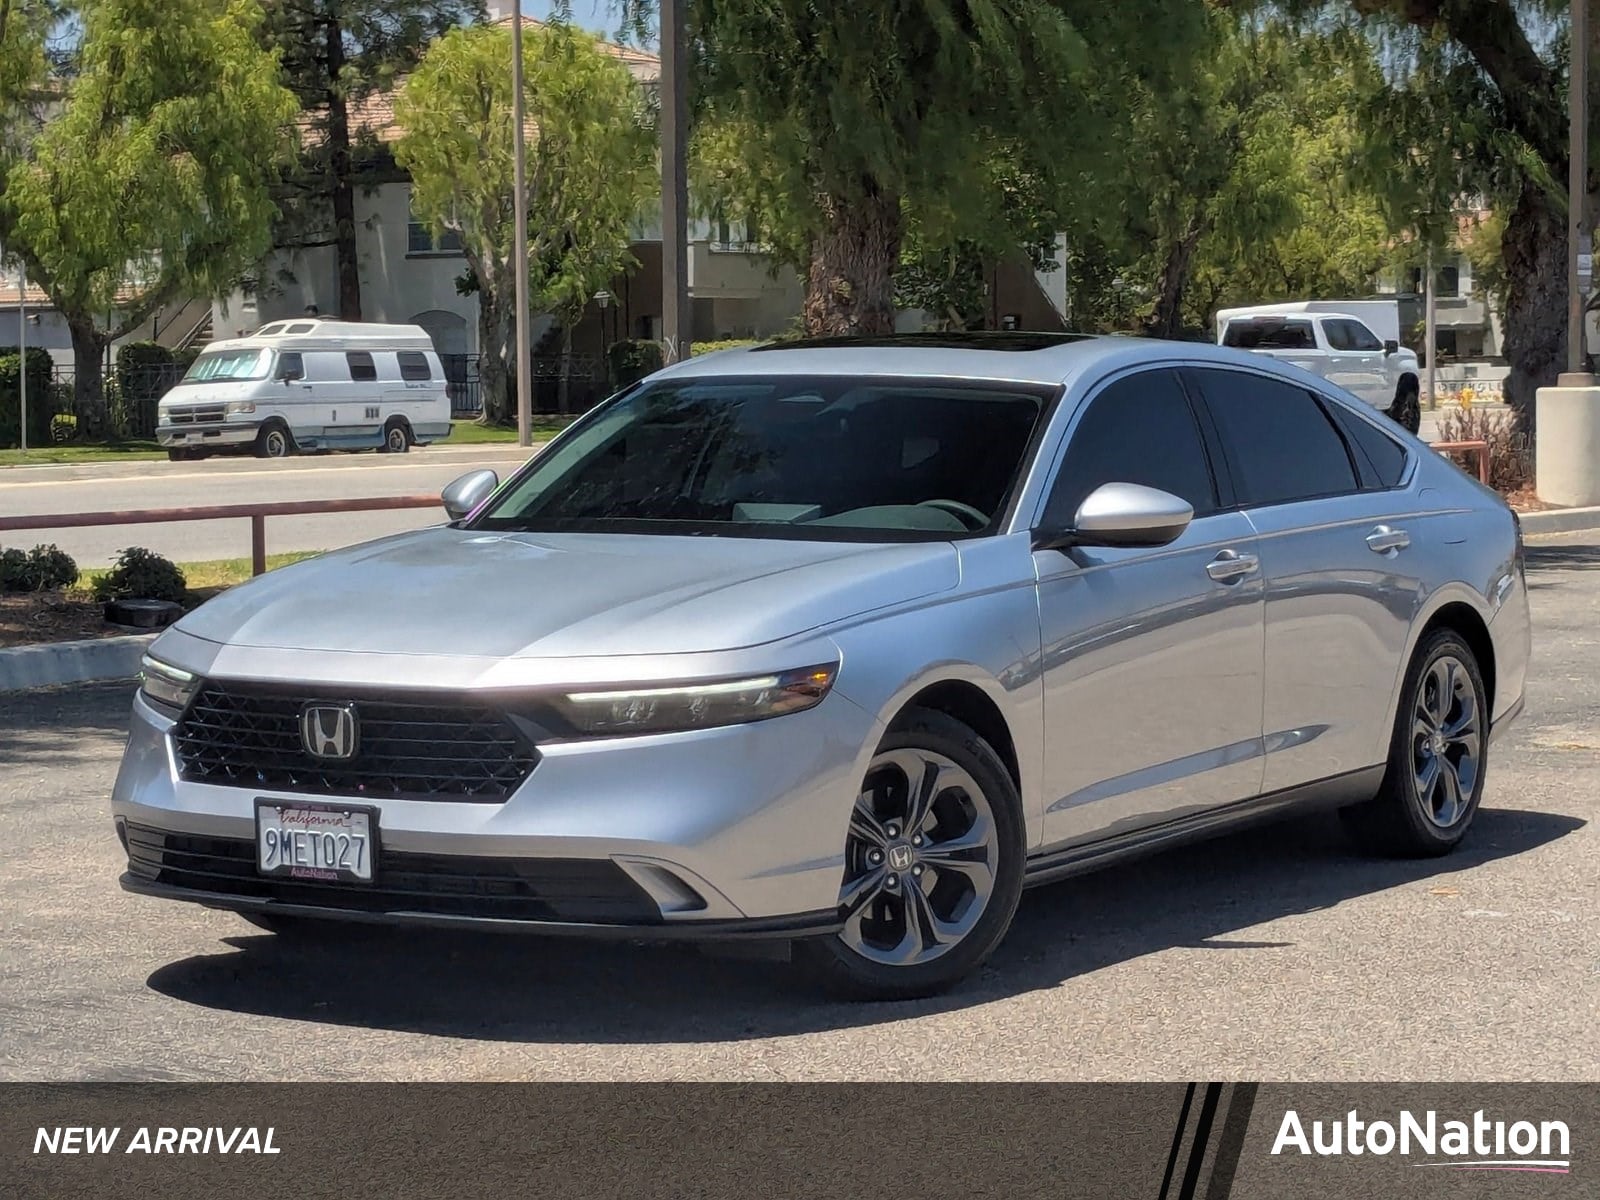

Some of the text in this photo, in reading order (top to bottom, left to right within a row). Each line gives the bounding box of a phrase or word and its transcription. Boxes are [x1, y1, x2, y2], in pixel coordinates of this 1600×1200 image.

[280, 808, 352, 828] California
[265, 828, 366, 870] 9MET027
[290, 867, 338, 880] AutoNation
